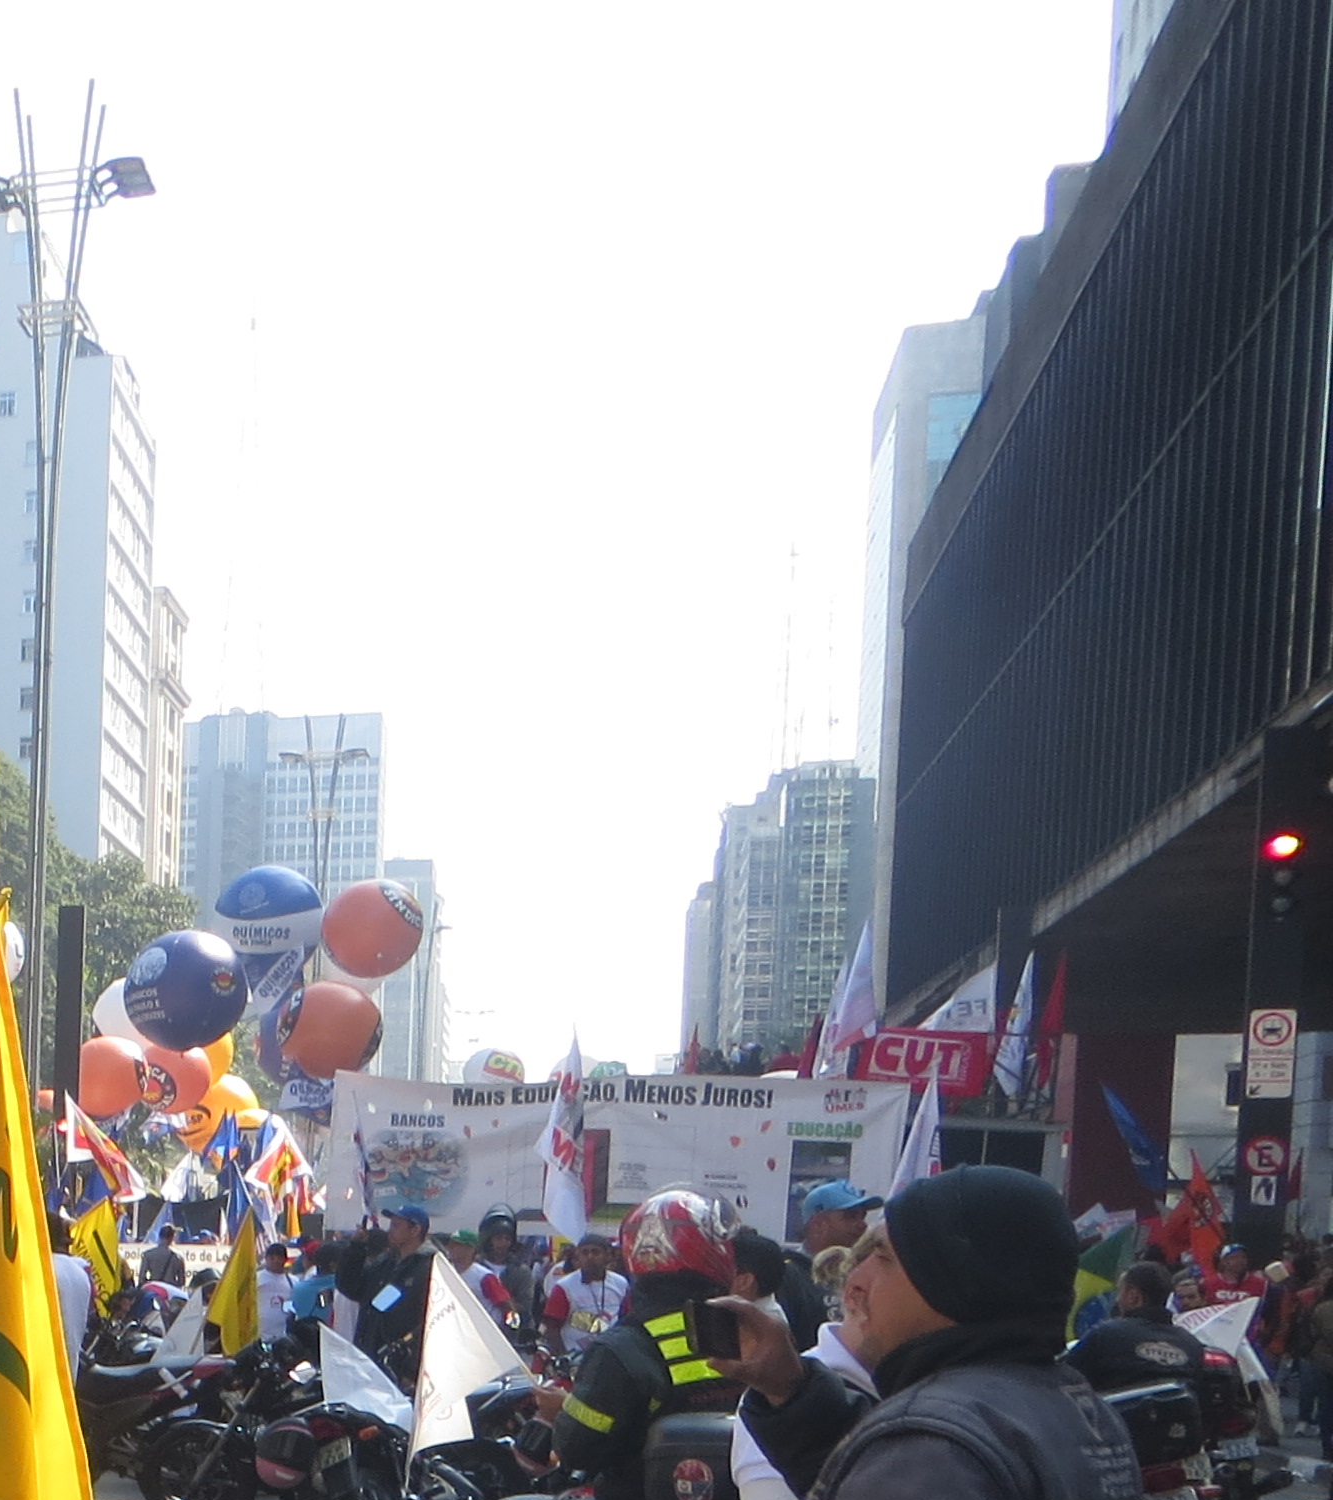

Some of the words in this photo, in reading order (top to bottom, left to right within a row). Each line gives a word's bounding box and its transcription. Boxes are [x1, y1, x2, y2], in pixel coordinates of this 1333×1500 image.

[873, 1037, 962, 1077] CUT
[390, 1112, 445, 1129] BANCOS
[786, 1121, 864, 1141] EDUCAÇÃO
